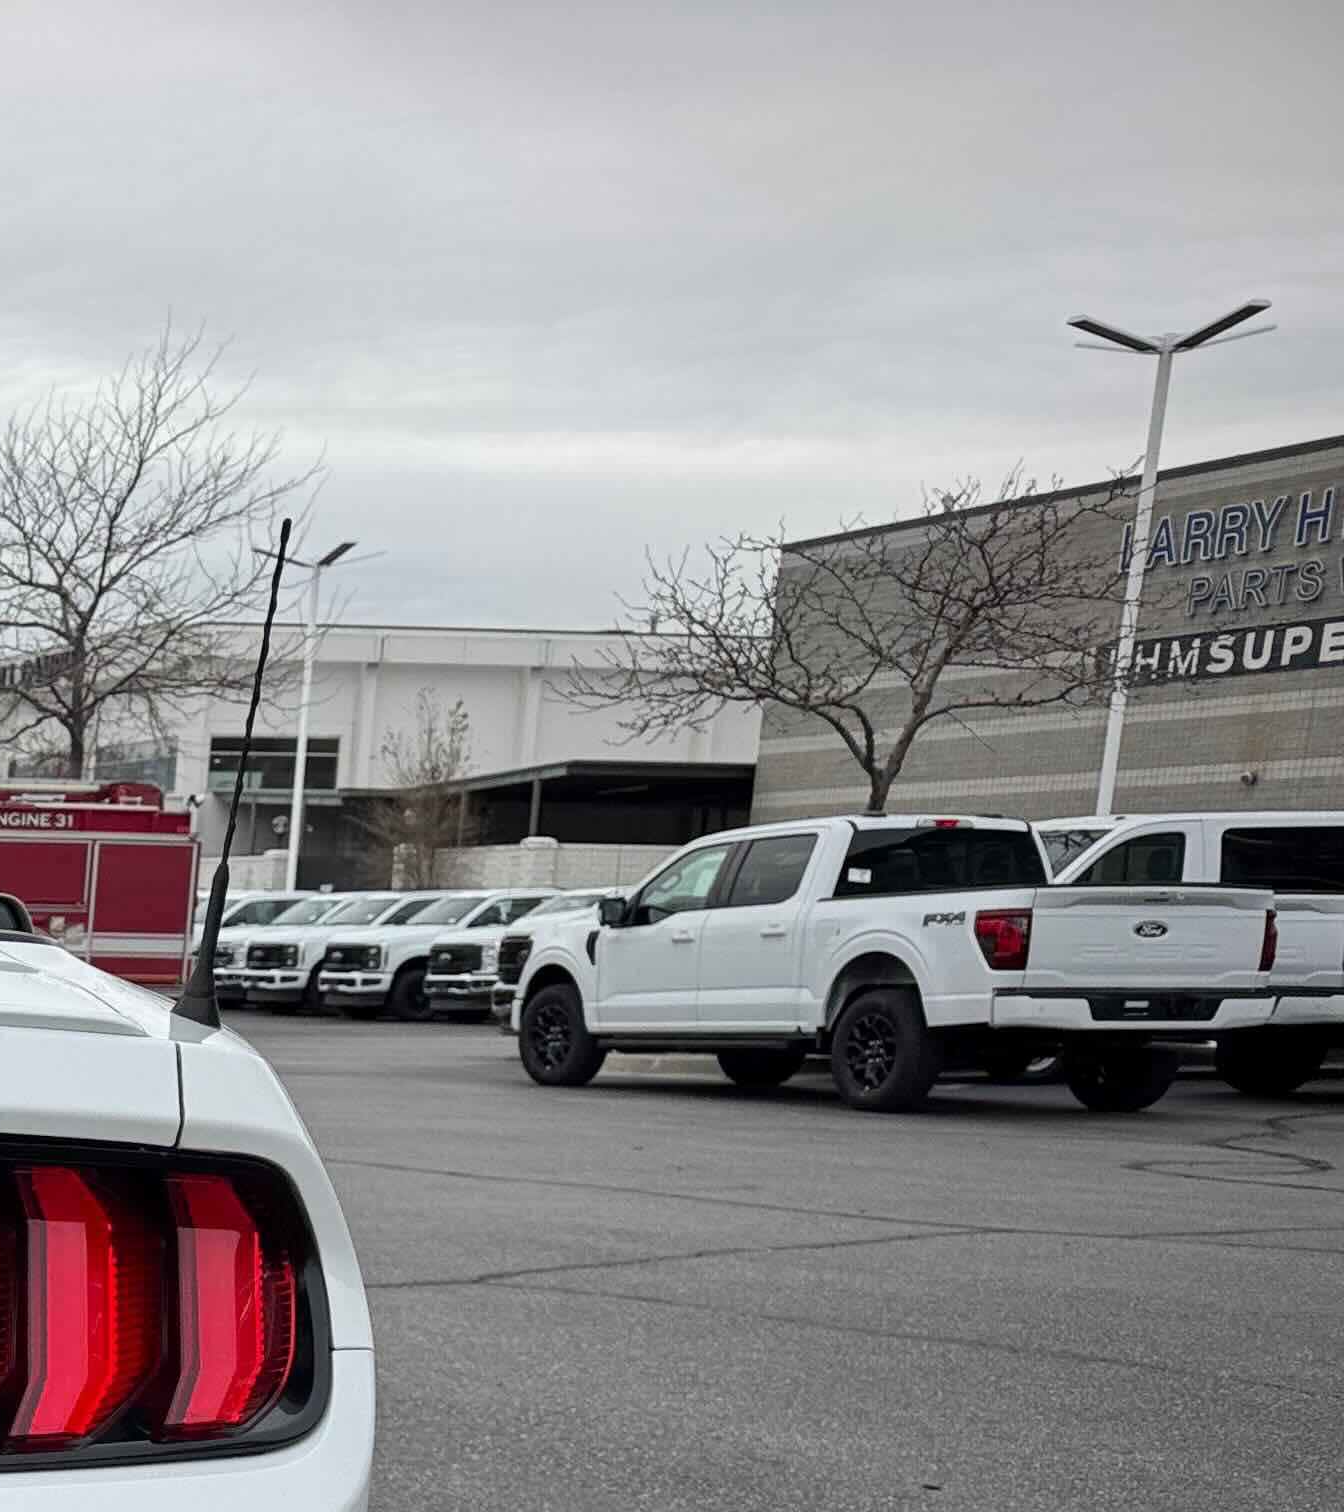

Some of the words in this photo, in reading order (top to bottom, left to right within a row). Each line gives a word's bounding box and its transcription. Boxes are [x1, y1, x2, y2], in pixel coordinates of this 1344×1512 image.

[1186, 559, 1326, 617] PARTS
[52, 813, 73, 829] 31
[922, 911, 966, 928] FX4
